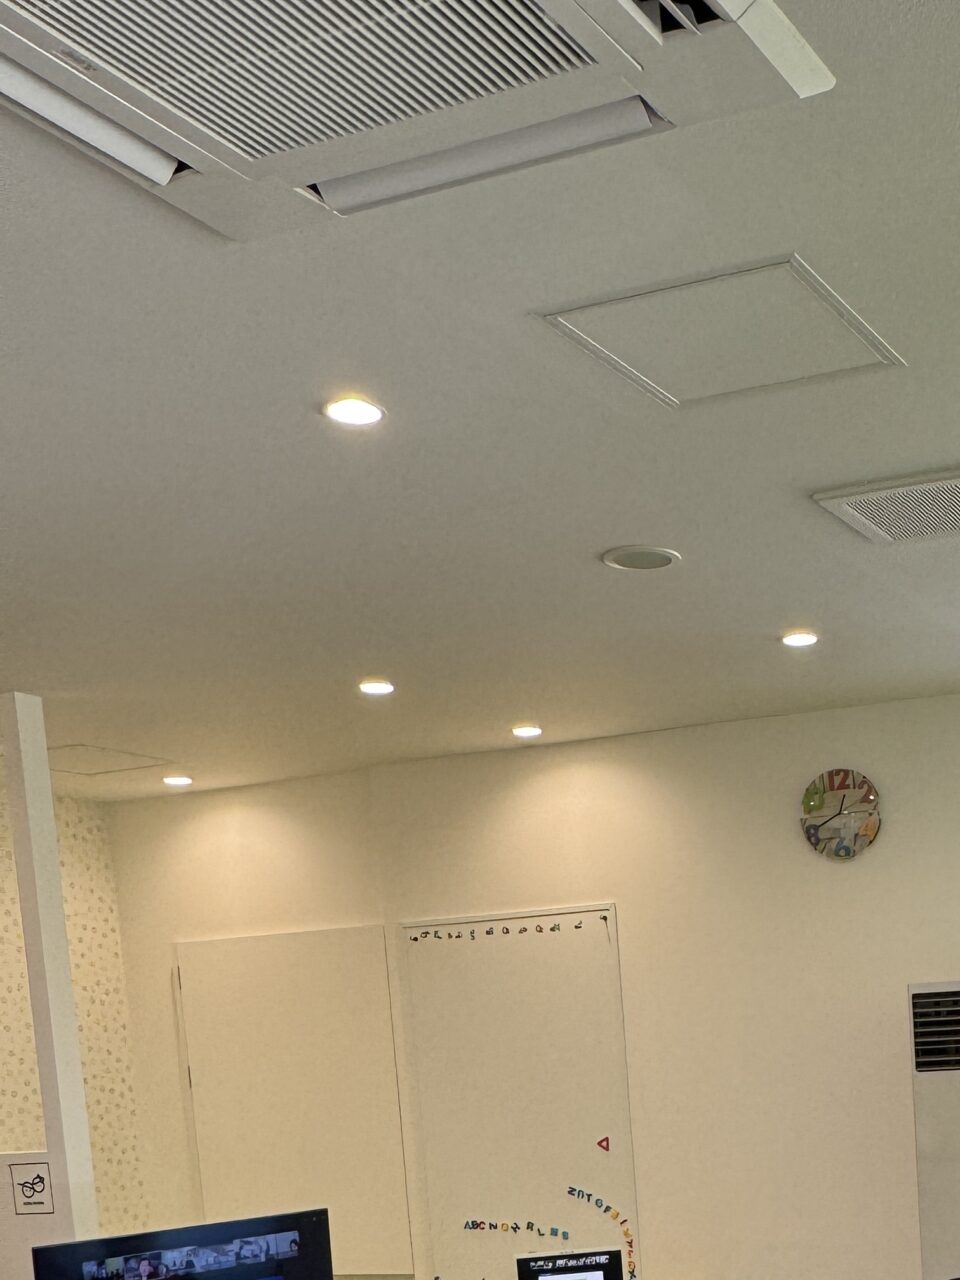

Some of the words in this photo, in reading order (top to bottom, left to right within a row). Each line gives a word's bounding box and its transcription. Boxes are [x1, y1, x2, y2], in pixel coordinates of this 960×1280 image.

[828, 769, 851, 791] 12
[858, 780, 874, 804] 2
[834, 837, 851, 857] 6
